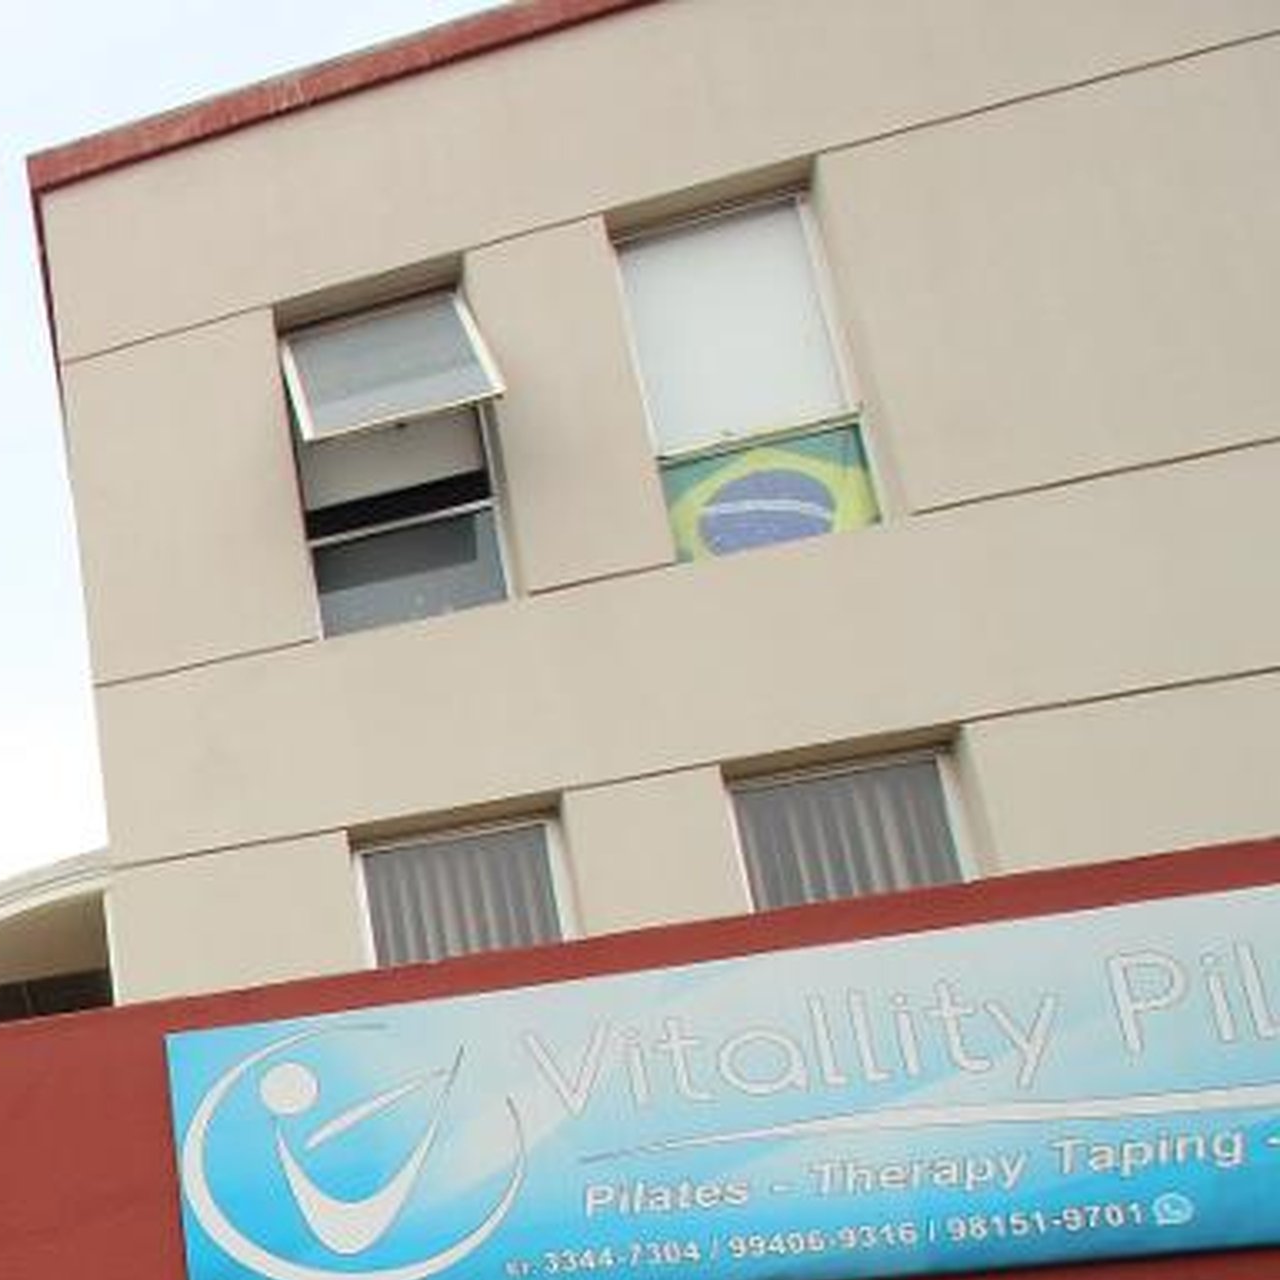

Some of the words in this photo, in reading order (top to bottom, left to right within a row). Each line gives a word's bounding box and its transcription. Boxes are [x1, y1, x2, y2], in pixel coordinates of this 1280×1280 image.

[523, 976, 1054, 1118] Vitallity
[584, 1176, 749, 1217] Pilates
[808, 1150, 1028, 1195] Therapy
[1049, 1128, 1247, 1178] Taping
[946, 1201, 1143, 1240] 98151-9701
